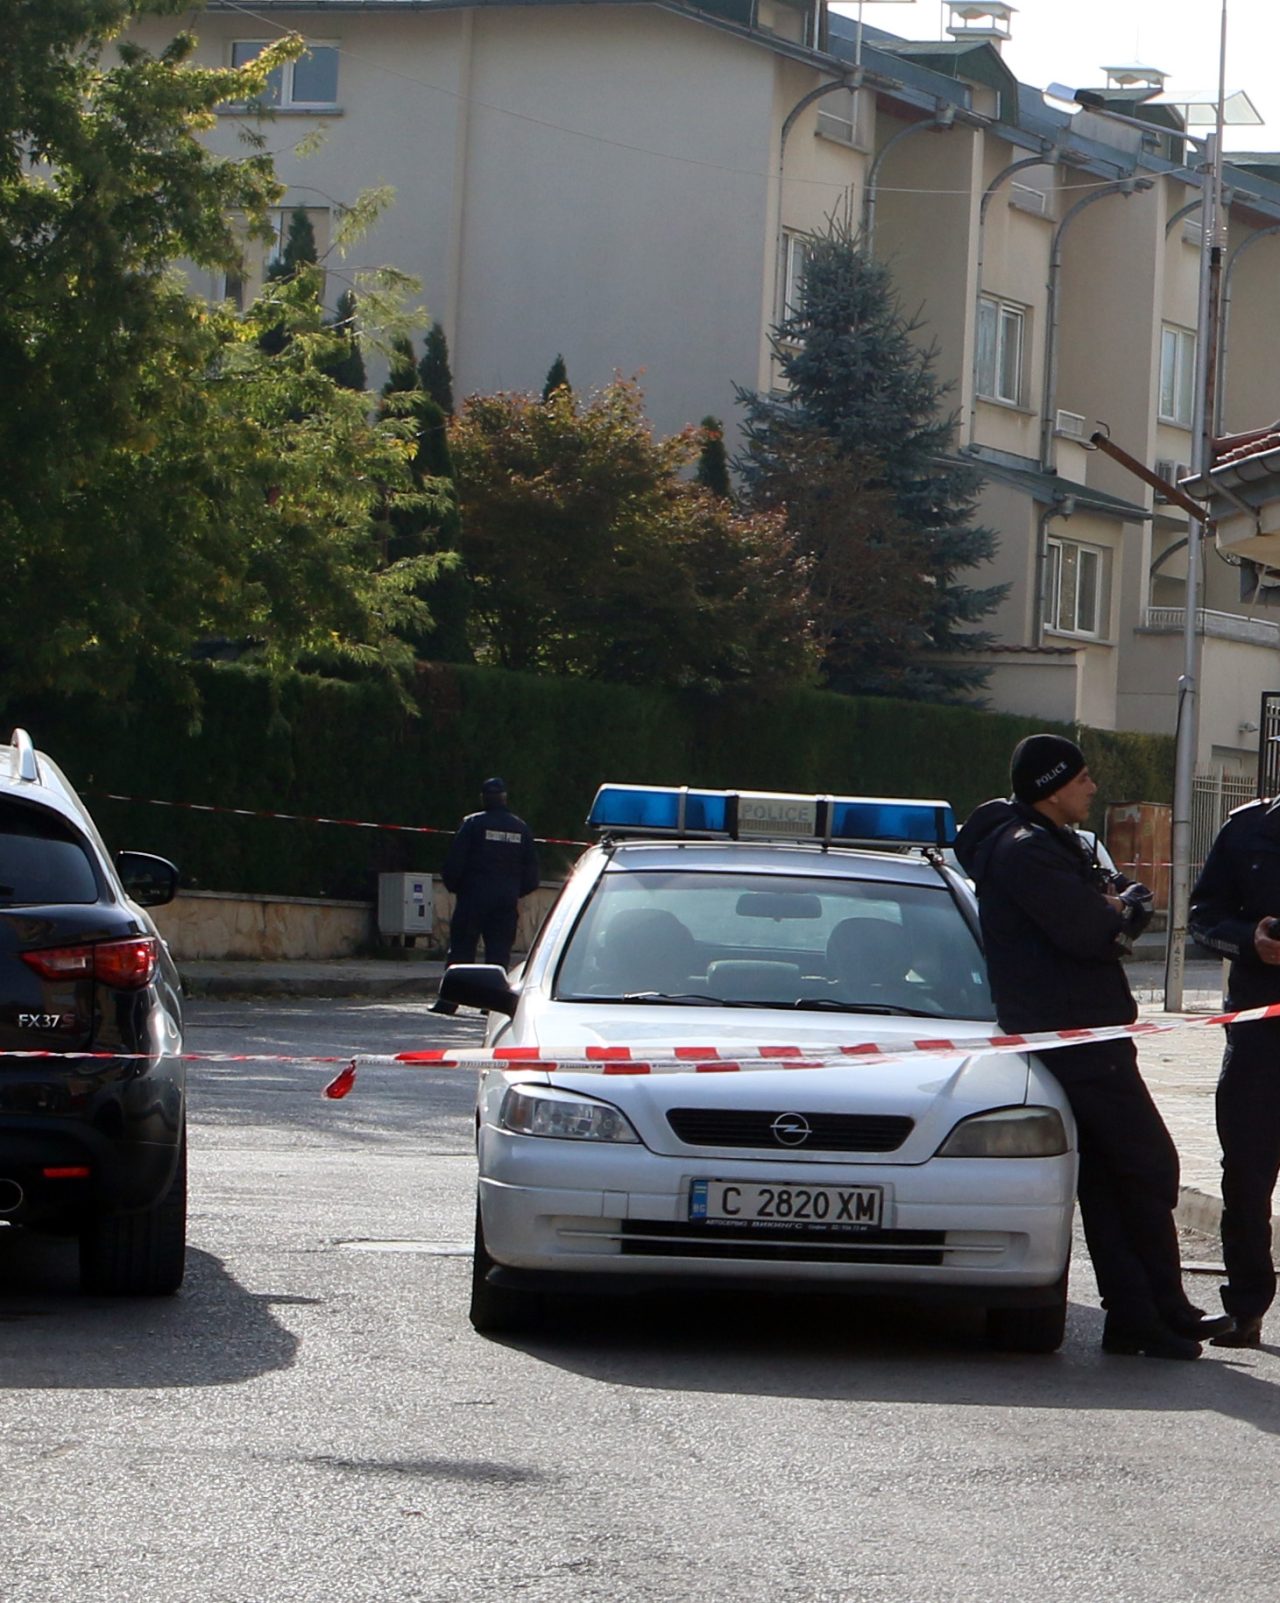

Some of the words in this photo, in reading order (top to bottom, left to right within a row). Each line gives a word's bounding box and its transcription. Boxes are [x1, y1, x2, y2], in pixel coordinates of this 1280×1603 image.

[1034, 761, 1068, 787] POLICE
[742, 804, 809, 821] POLICE
[722, 1187, 742, 1215] C
[757, 1189, 829, 1219] 2820
[837, 1192, 876, 1221] XM
